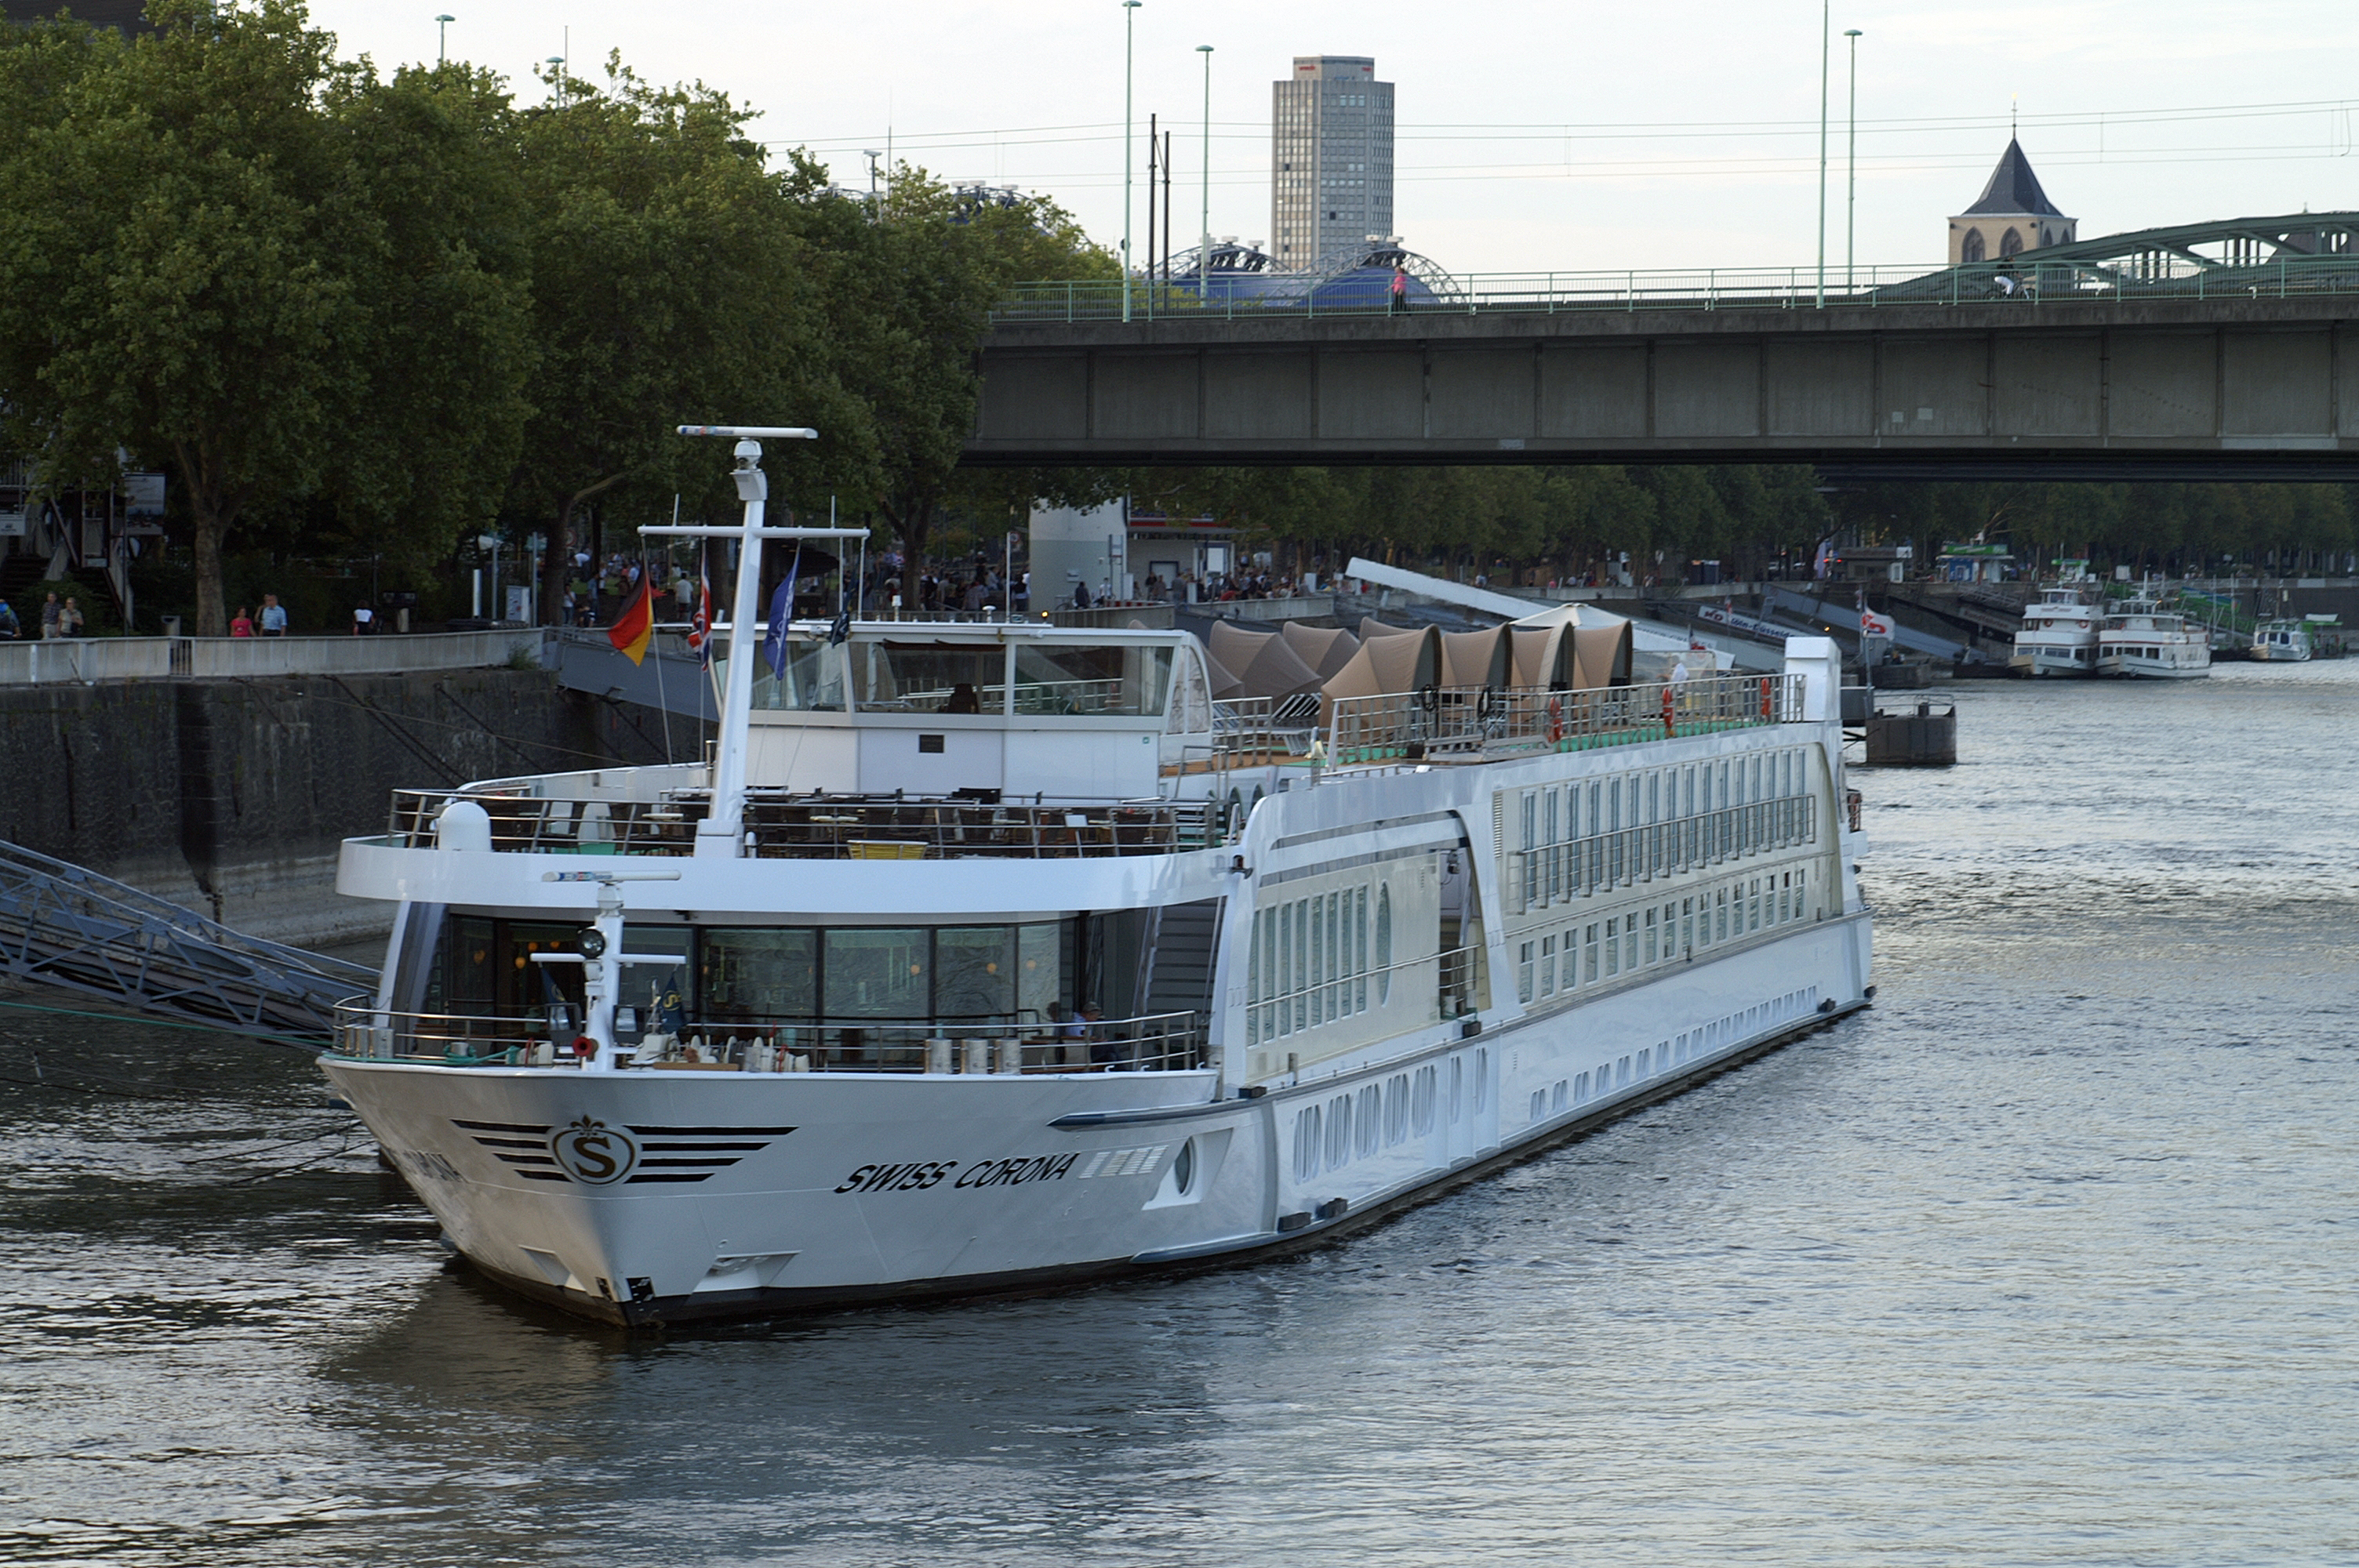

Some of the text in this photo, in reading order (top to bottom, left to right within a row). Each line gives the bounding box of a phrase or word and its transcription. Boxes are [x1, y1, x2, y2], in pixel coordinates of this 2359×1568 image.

[573, 1136, 616, 1178] S
[833, 1152, 1081, 1193] SWISS CORONA
